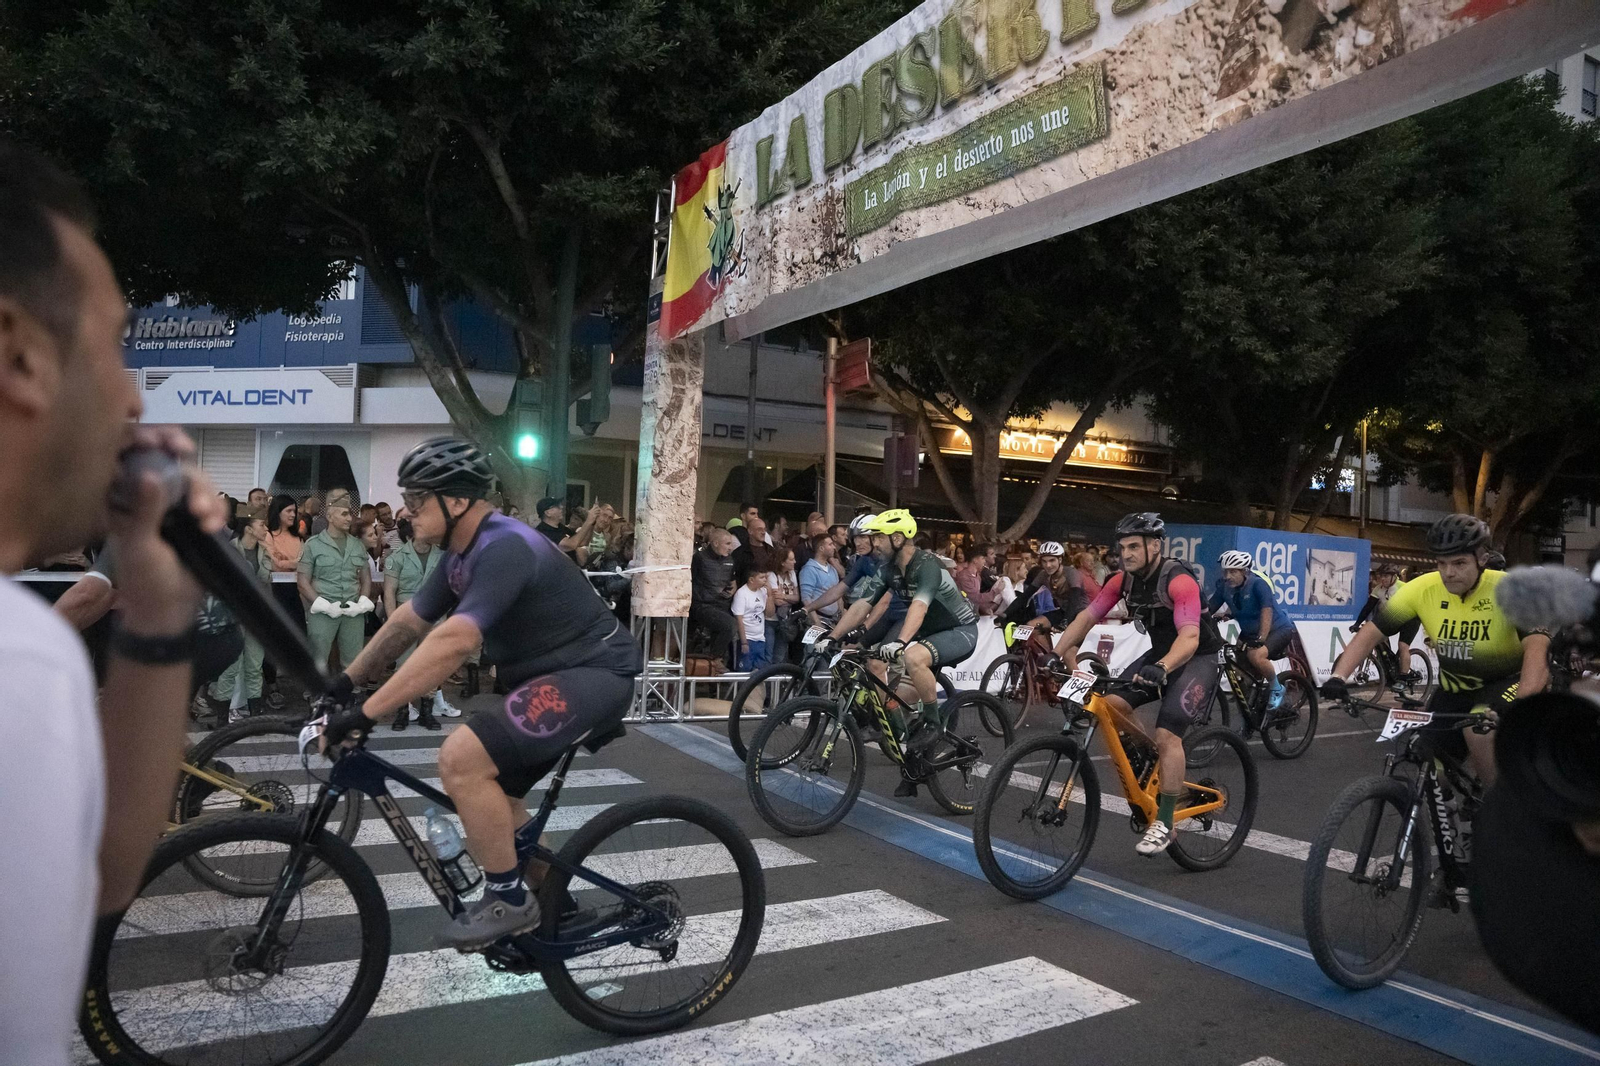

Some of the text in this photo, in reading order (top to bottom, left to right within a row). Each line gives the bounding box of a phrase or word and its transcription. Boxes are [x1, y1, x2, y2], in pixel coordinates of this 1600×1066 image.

[755, 112, 812, 207] LA
[864, 105, 1070, 211] La Legión y el desierto nos une
[135, 339, 235, 351] Centro Interdisciplinar
[284, 330, 345, 343] Fisioterapia
[177, 388, 314, 406] VITALDENT
[1255, 541, 1298, 577] gar
[1437, 618, 1492, 641] ALBOX
[1437, 639, 1475, 661] BIKE
[956, 671, 966, 681] DE
[375, 793, 456, 917] BERRIA
[574, 940, 608, 953] MAKO
[688, 970, 734, 1015] MAXXIS
[86, 988, 121, 1056] MAXXIS
